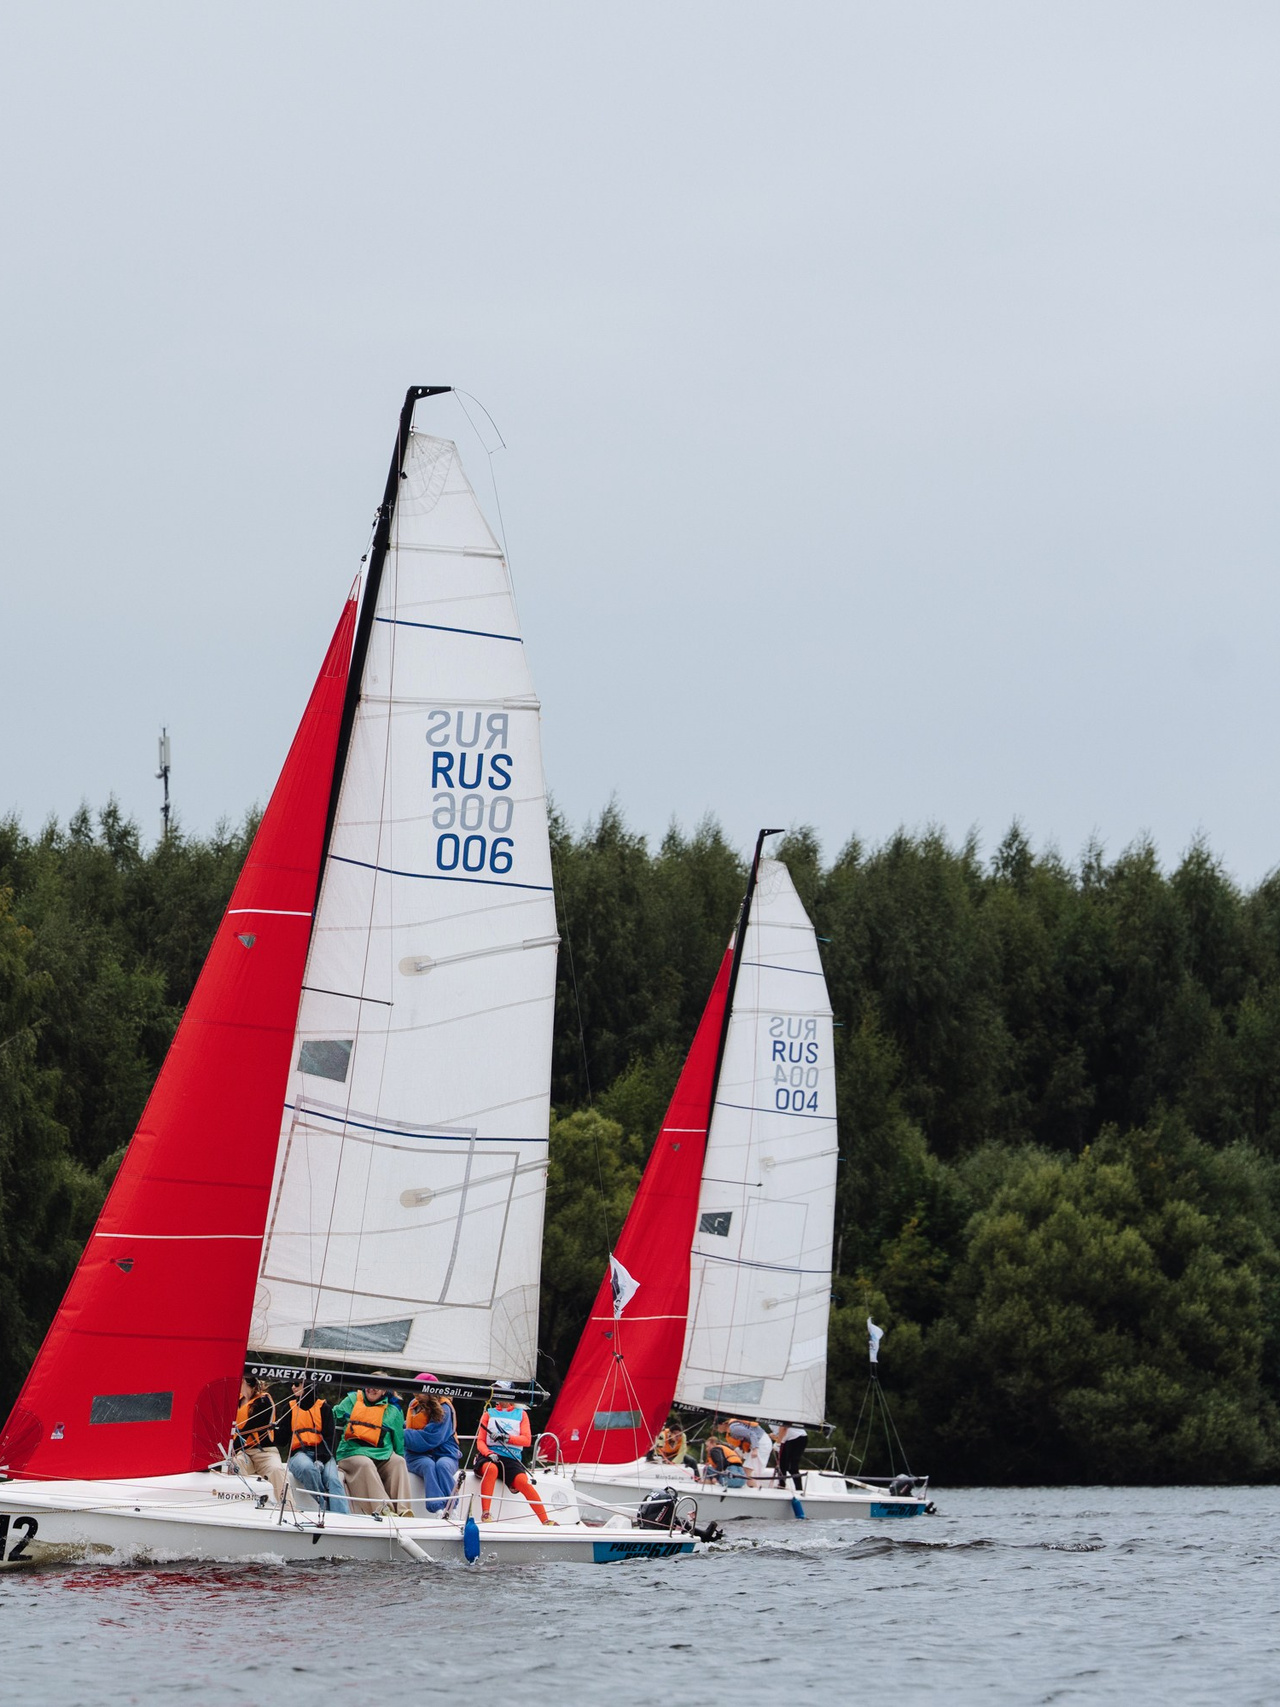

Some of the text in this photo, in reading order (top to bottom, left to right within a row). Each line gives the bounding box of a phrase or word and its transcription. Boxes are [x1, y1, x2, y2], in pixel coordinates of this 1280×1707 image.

[431, 751, 514, 791] RUS
[436, 833, 514, 874] 006
[772, 1039, 819, 1064] RUS
[775, 1088, 819, 1112] 004
[421, 1384, 473, 1398] MoreSail.ru
[648, 1542, 683, 1559] 670
